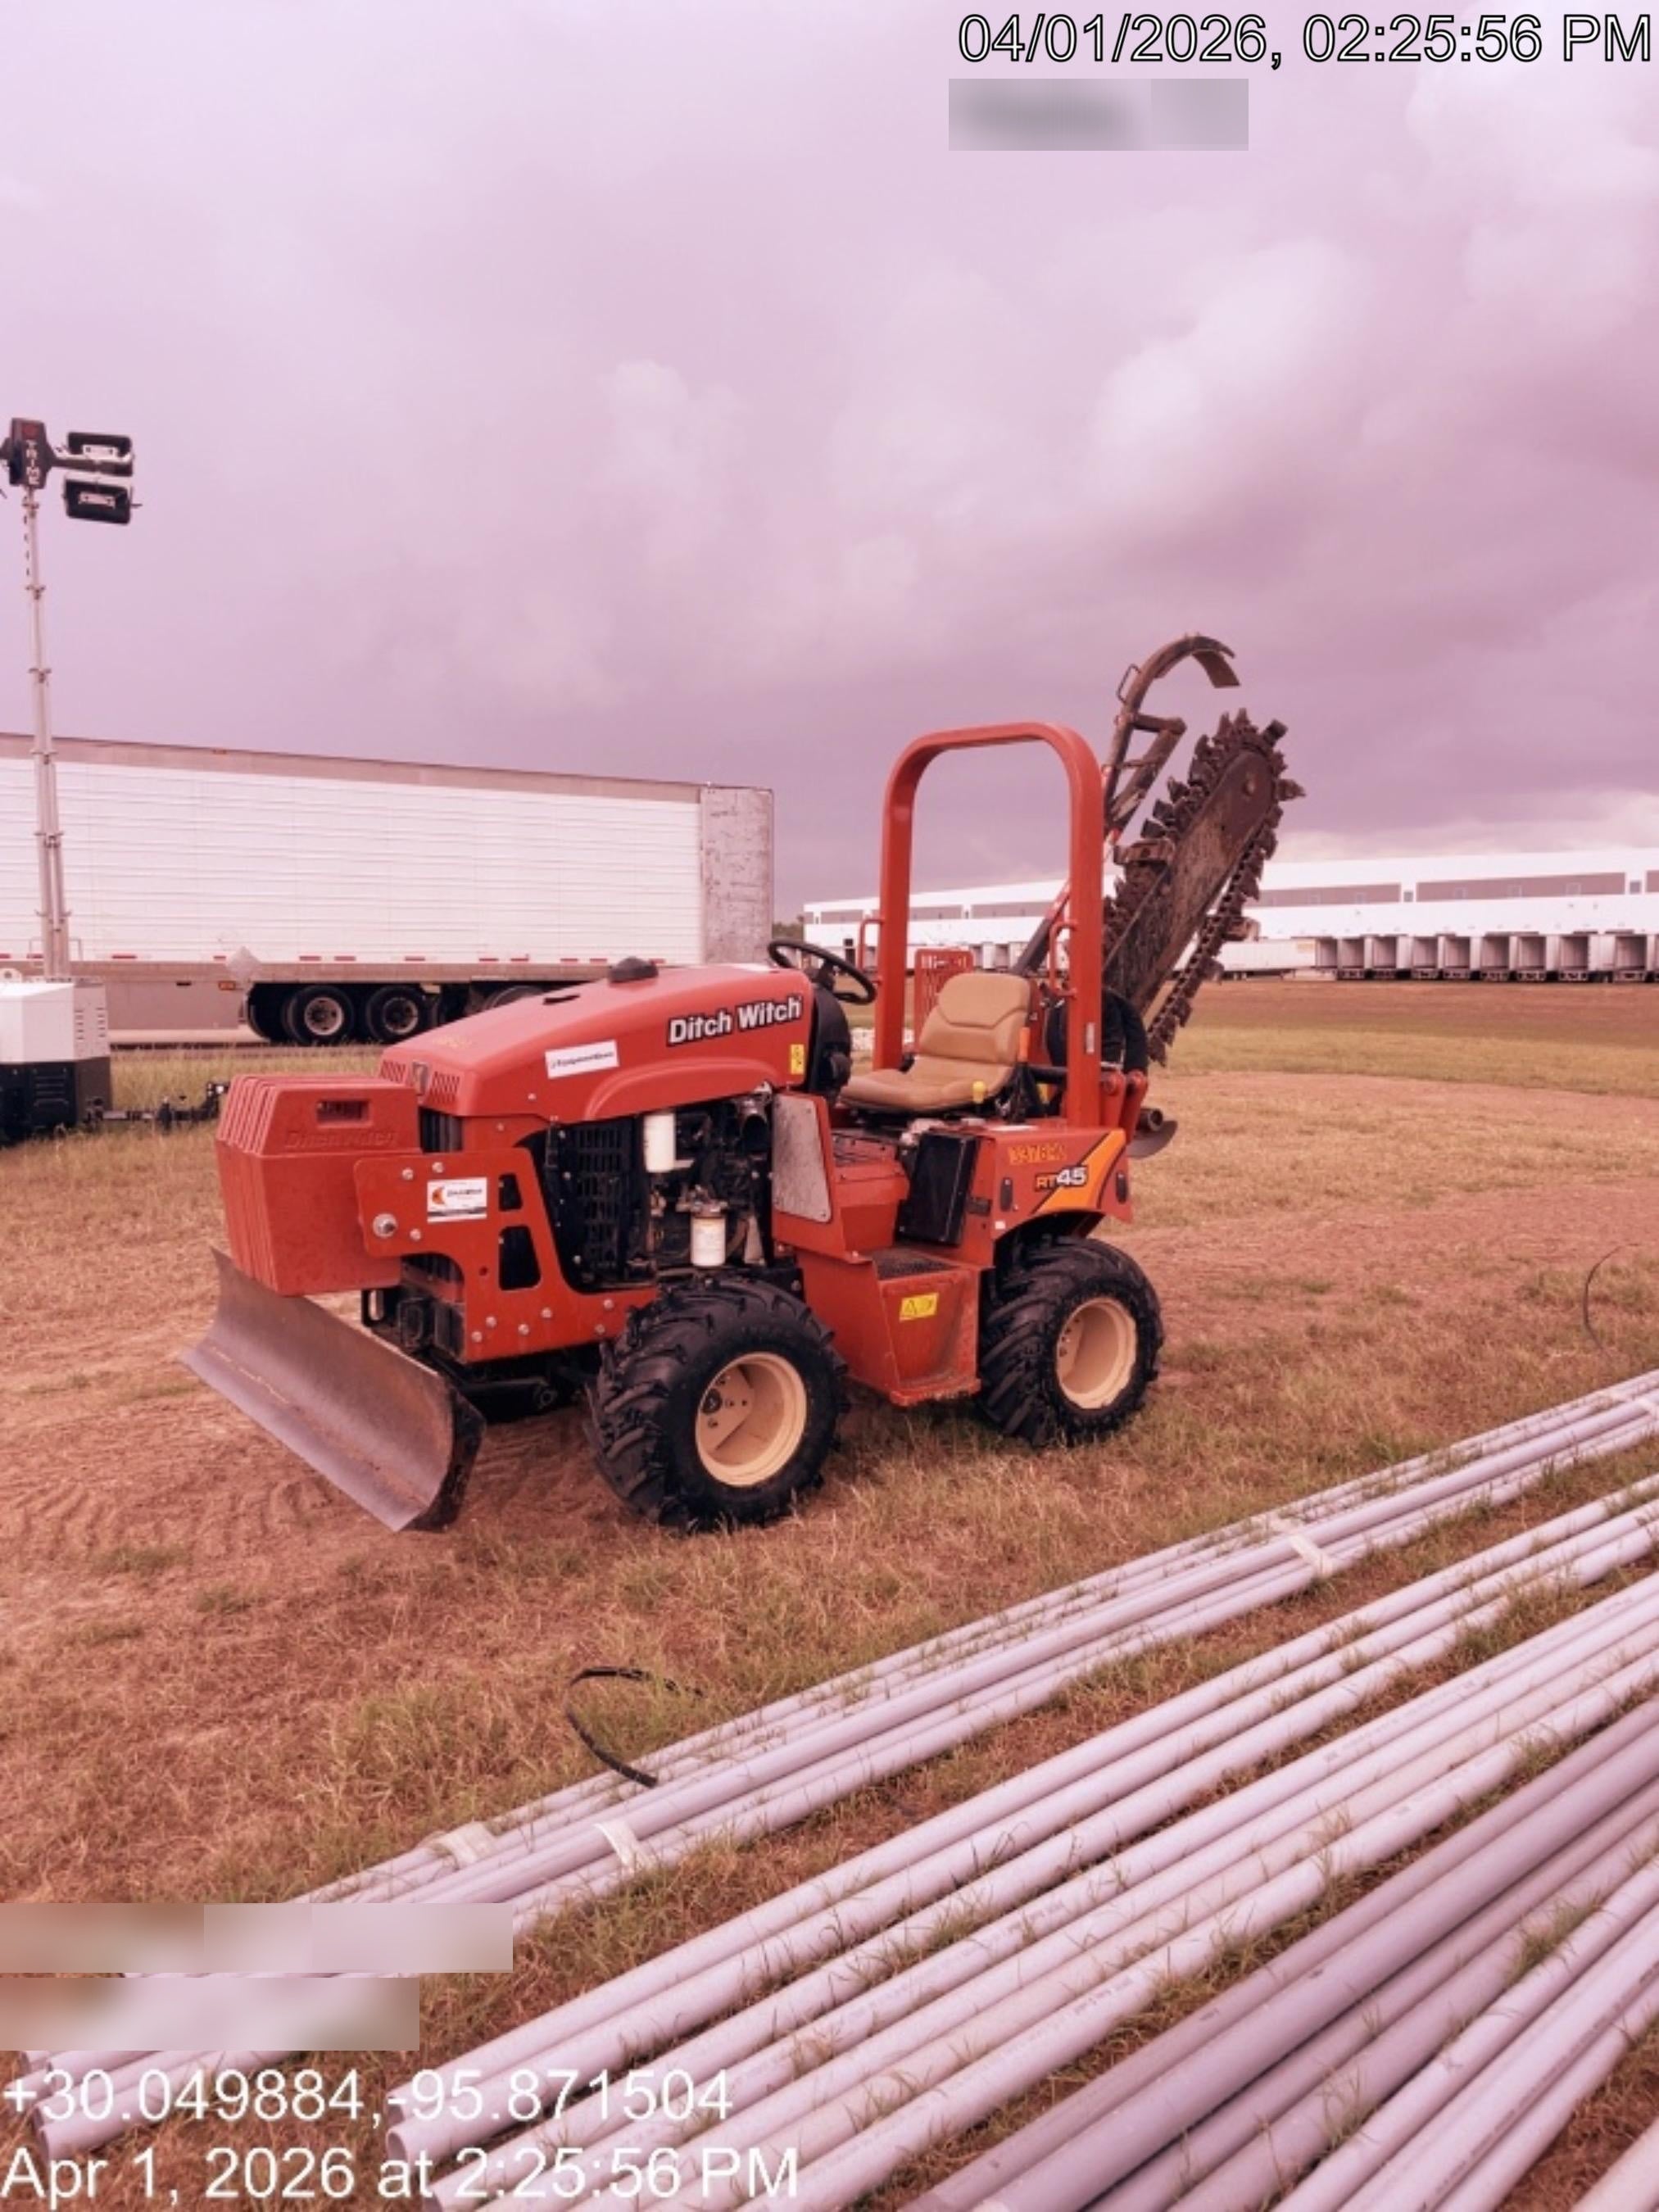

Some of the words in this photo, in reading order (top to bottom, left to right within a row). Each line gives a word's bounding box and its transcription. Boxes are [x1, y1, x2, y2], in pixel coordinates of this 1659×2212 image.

[668, 1009, 732, 1044] Ditch
[737, 995, 800, 1029] Witch
[1036, 1167, 1087, 1188] RT45
